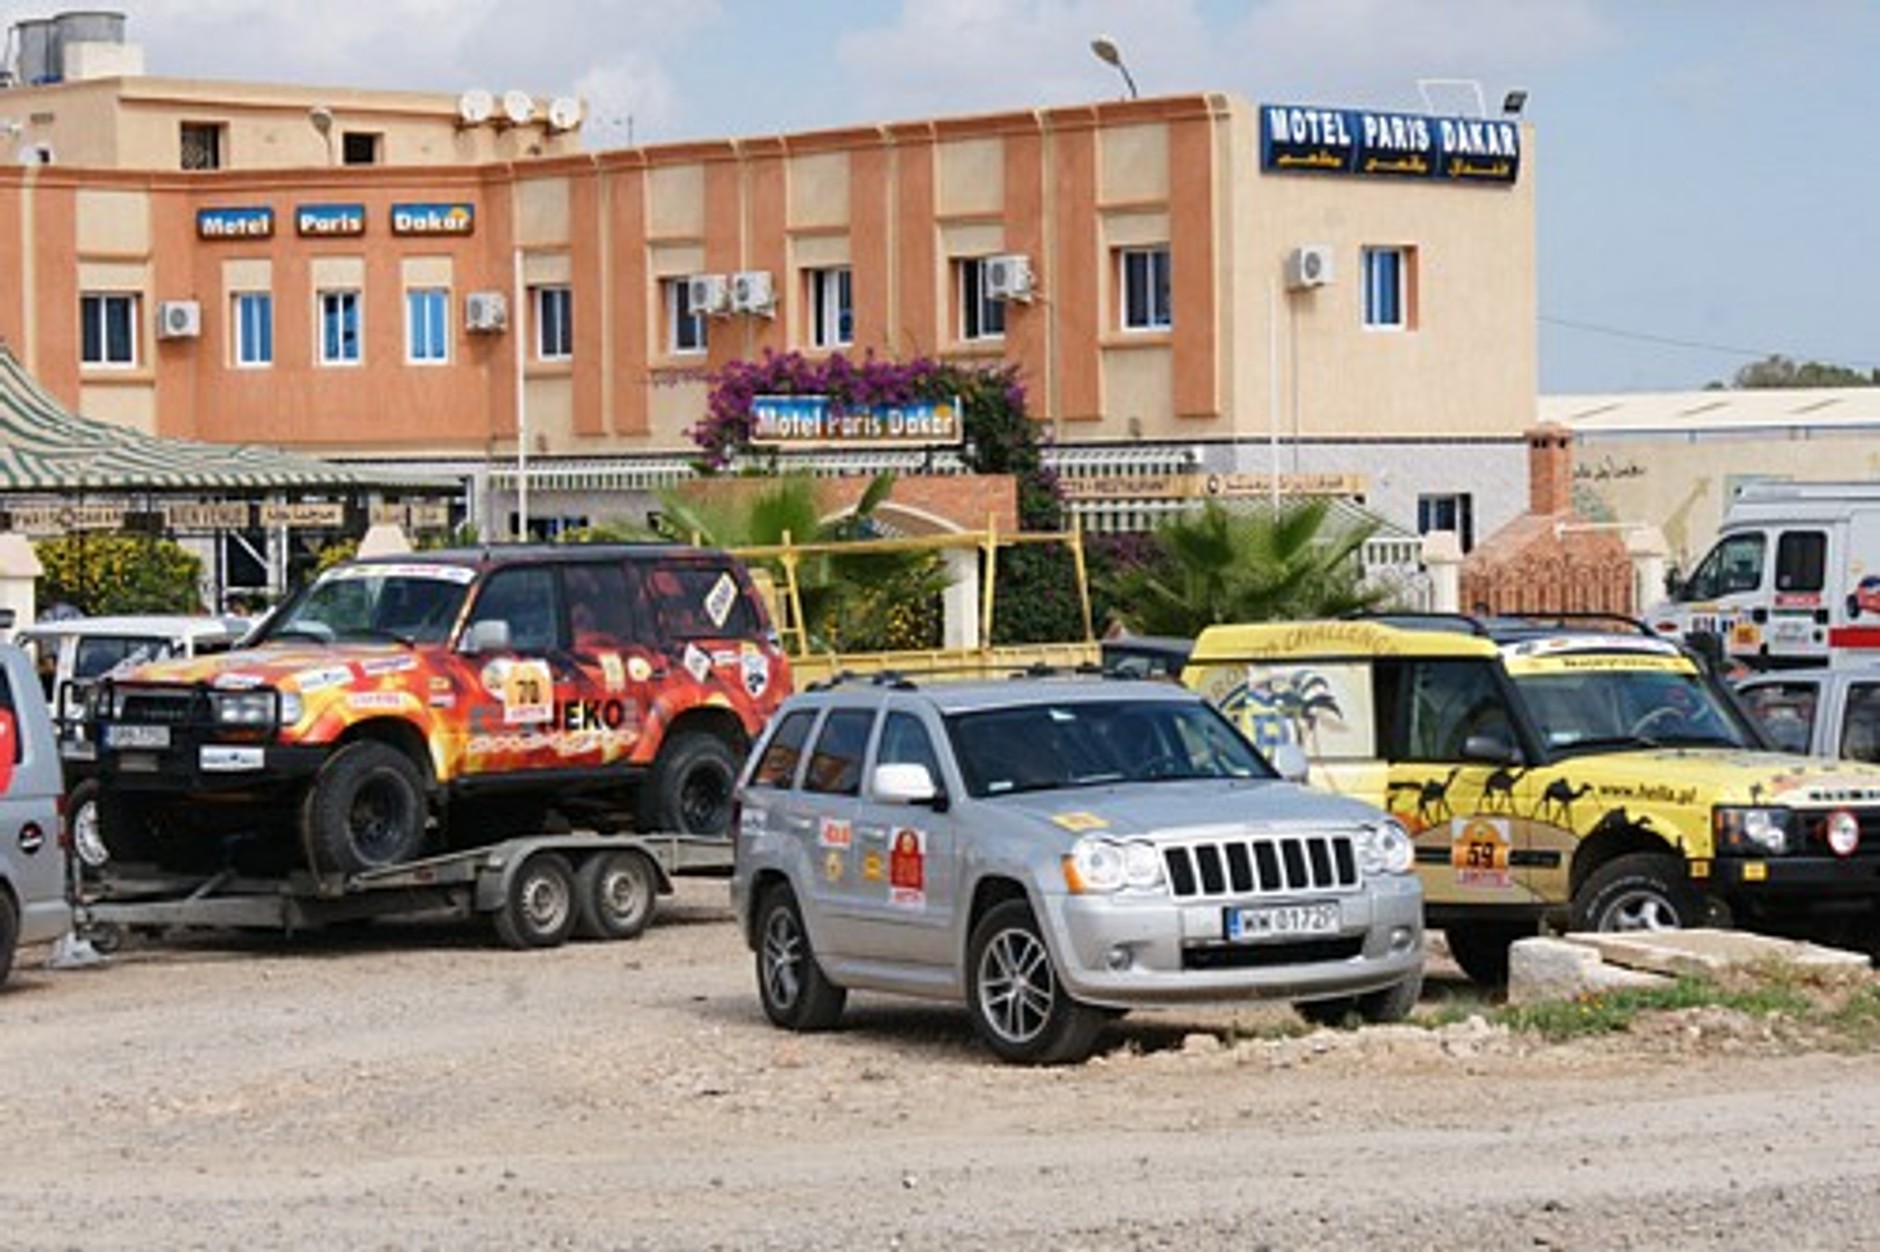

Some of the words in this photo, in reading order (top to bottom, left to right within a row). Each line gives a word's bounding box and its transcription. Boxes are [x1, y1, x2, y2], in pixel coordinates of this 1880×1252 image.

[1270, 108, 1350, 145] MOTEL
[1362, 115, 1430, 151] PARIS
[1440, 119, 1516, 156] DAKAR
[202, 214, 269, 235] Motel
[300, 212, 361, 231] Paris
[394, 210, 470, 231] Dakar
[756, 406, 822, 436] Motel
[888, 408, 953, 435] Dakar
[1467, 841, 1495, 868] 59
